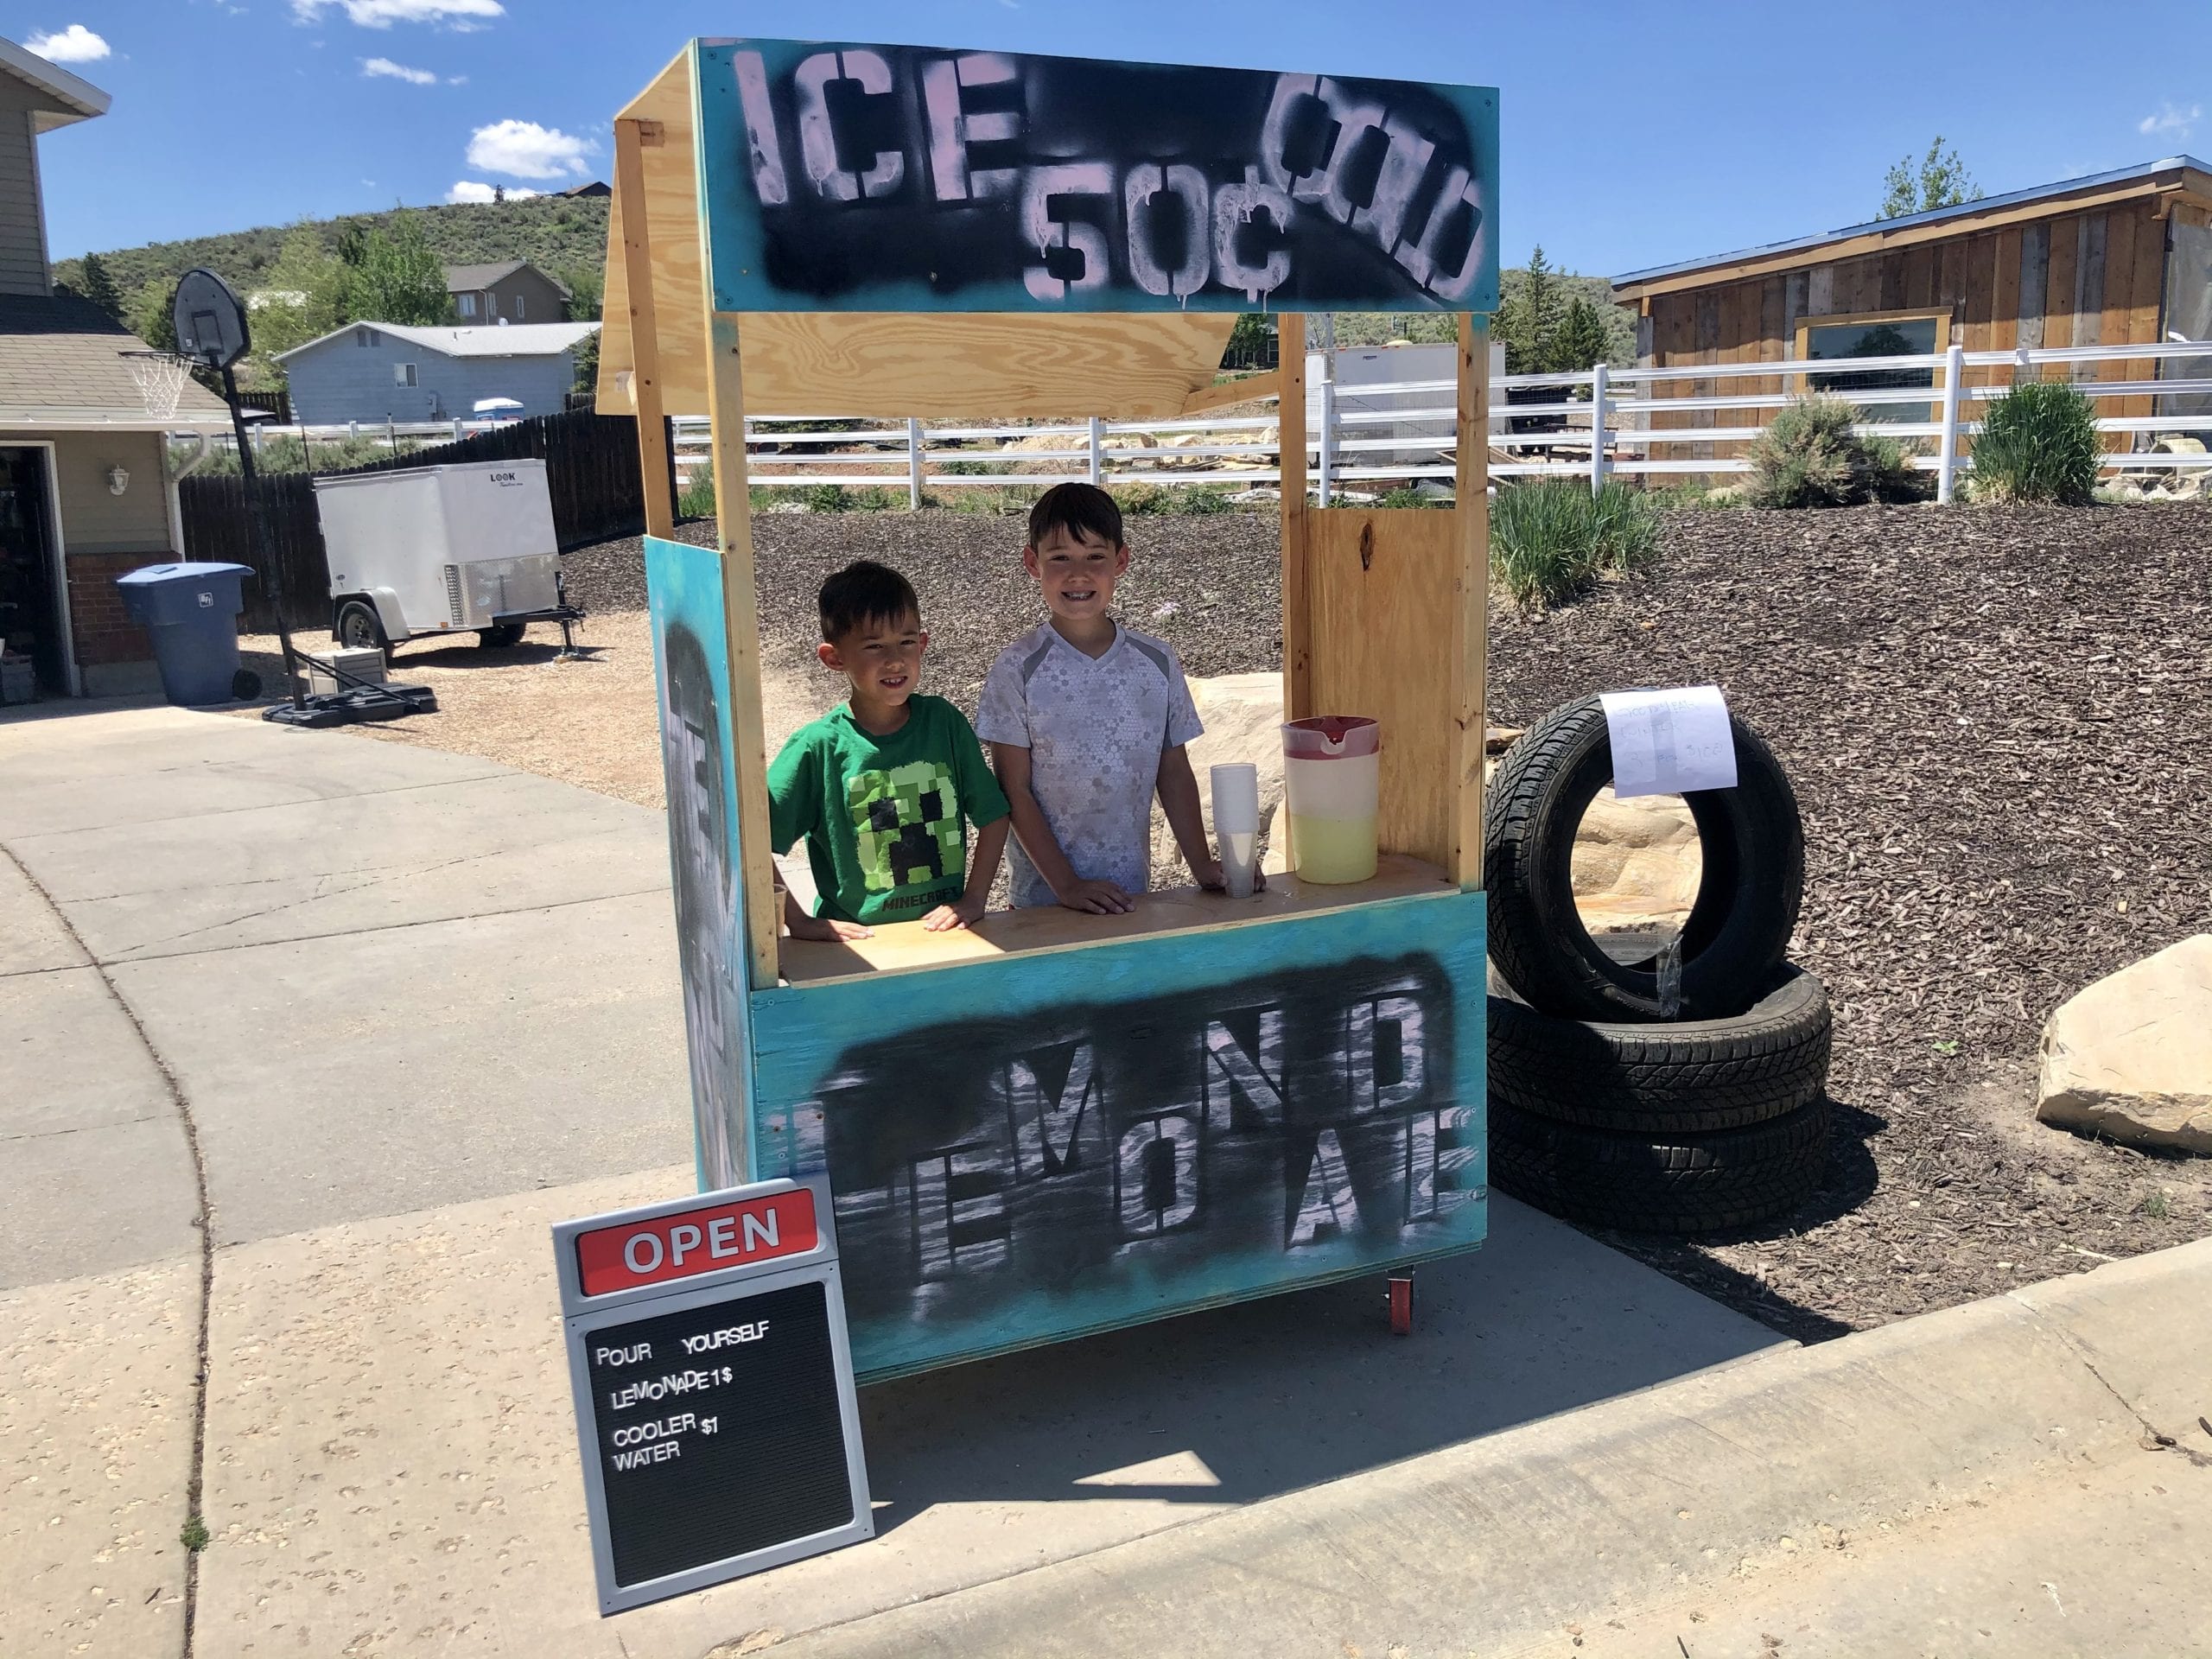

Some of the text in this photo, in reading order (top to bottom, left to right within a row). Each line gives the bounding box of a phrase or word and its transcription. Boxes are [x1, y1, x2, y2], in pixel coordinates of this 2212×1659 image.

[733, 49, 1486, 301] ICE COLD
[490, 472, 516, 482] LOOK
[882, 886, 959, 912] MINECRAFT
[624, 1208, 780, 1274] OPEN
[596, 1320, 770, 1367] POUR YOURSELF
[613, 1413, 718, 1446] COOLER $1
[613, 1440, 680, 1471] WATER
